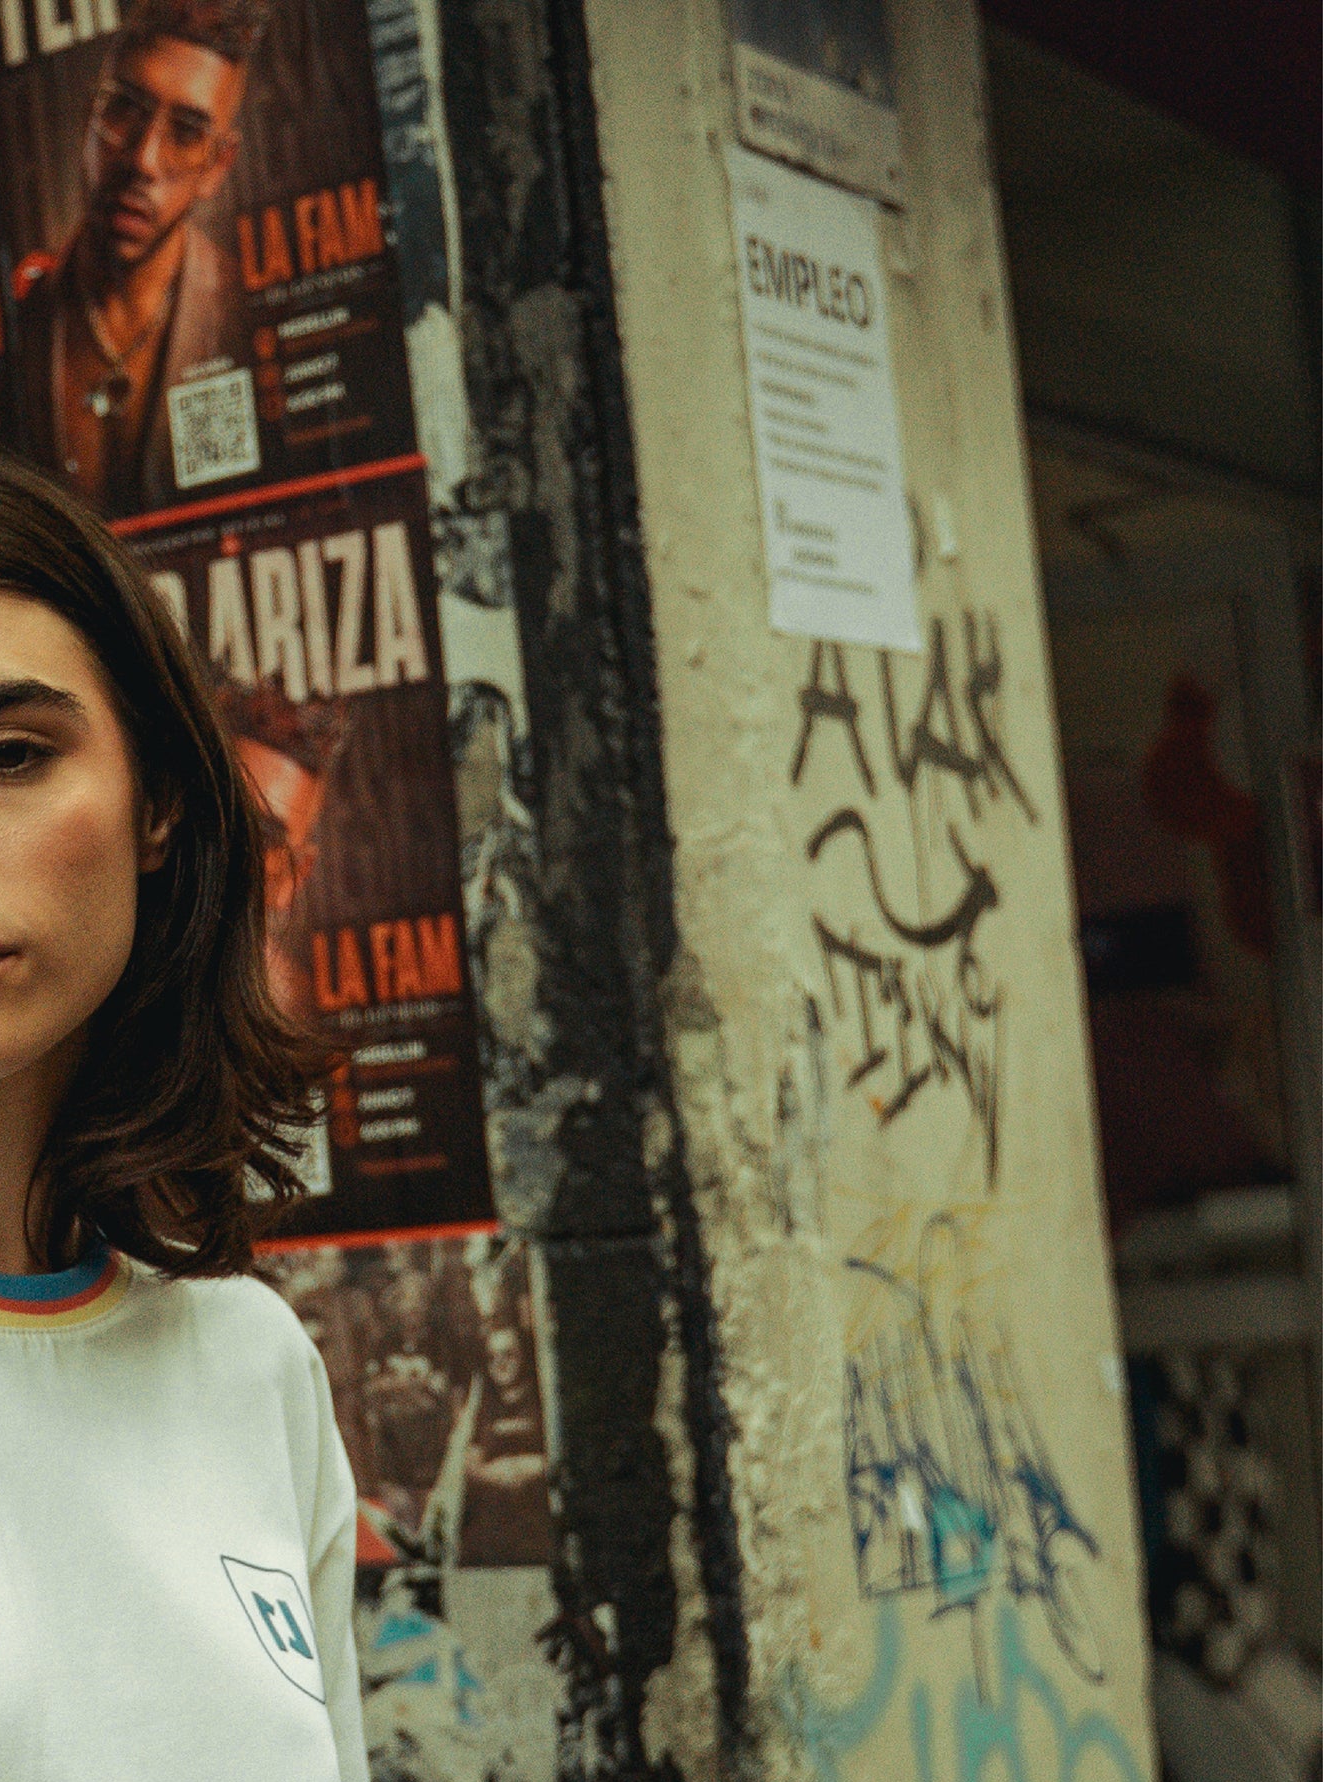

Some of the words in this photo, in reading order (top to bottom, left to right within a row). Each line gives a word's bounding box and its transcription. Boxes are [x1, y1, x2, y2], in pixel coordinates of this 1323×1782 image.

[236, 214, 293, 291] LA
[294, 178, 384, 273] FAM
[745, 235, 872, 330] EMPLEO
[207, 520, 429, 704] ARIZA
[312, 932, 368, 1012] LA
[370, 914, 462, 1003] FAM
